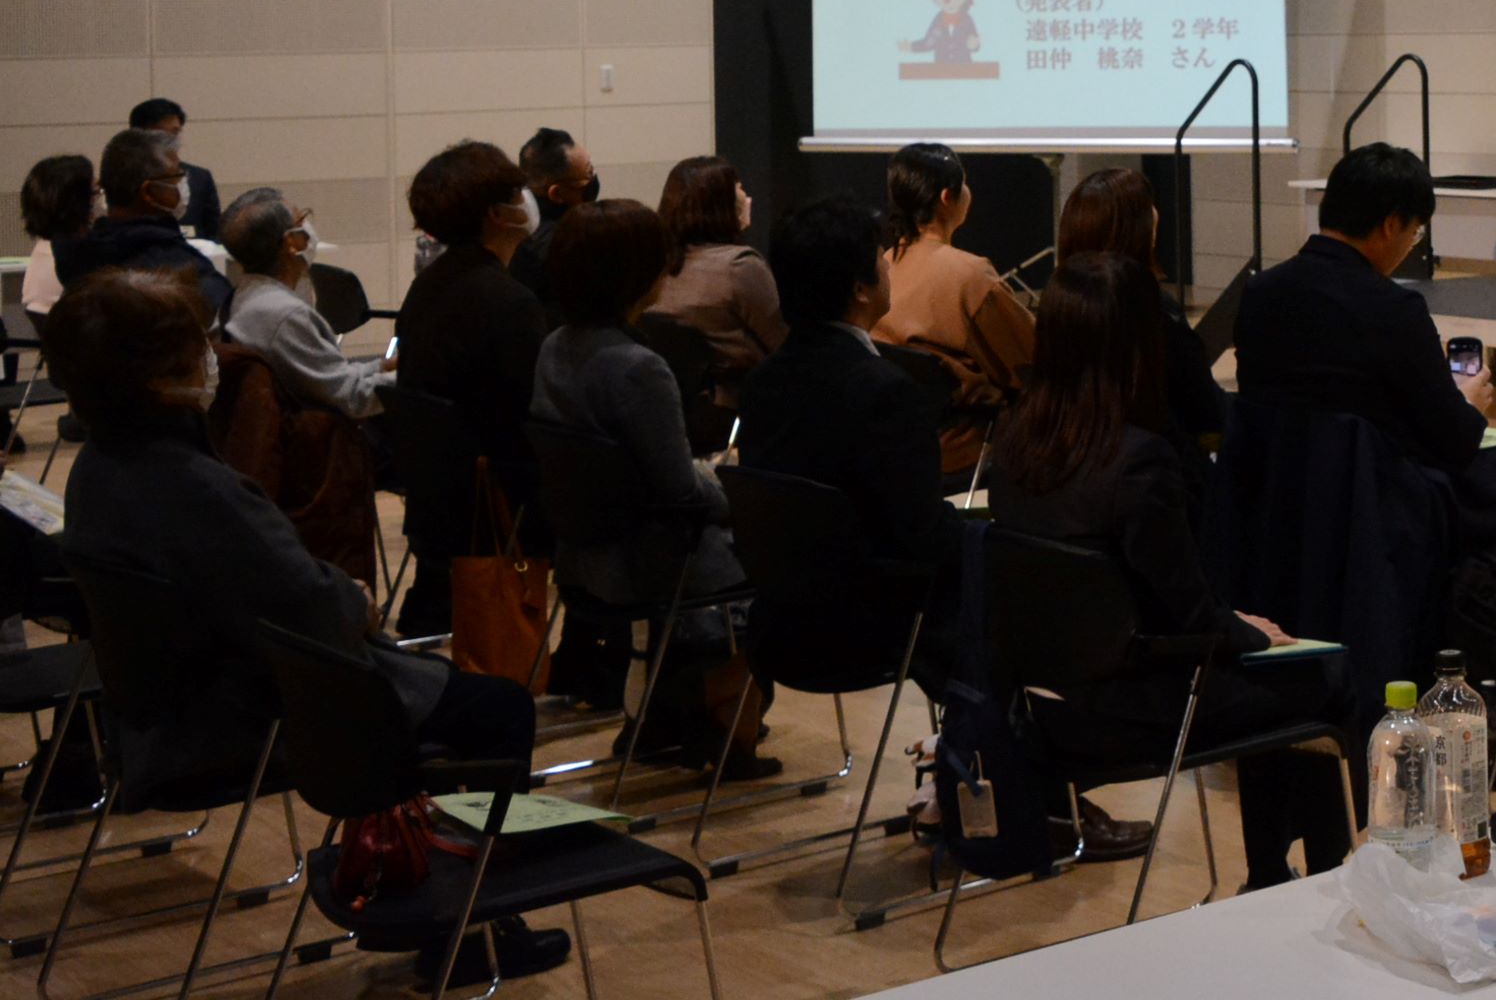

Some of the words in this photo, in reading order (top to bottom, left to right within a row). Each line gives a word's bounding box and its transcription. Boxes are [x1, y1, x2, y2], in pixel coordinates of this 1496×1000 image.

[1025, 18, 1143, 41] 遠軽中学校
[1171, 48, 1214, 69] さん
